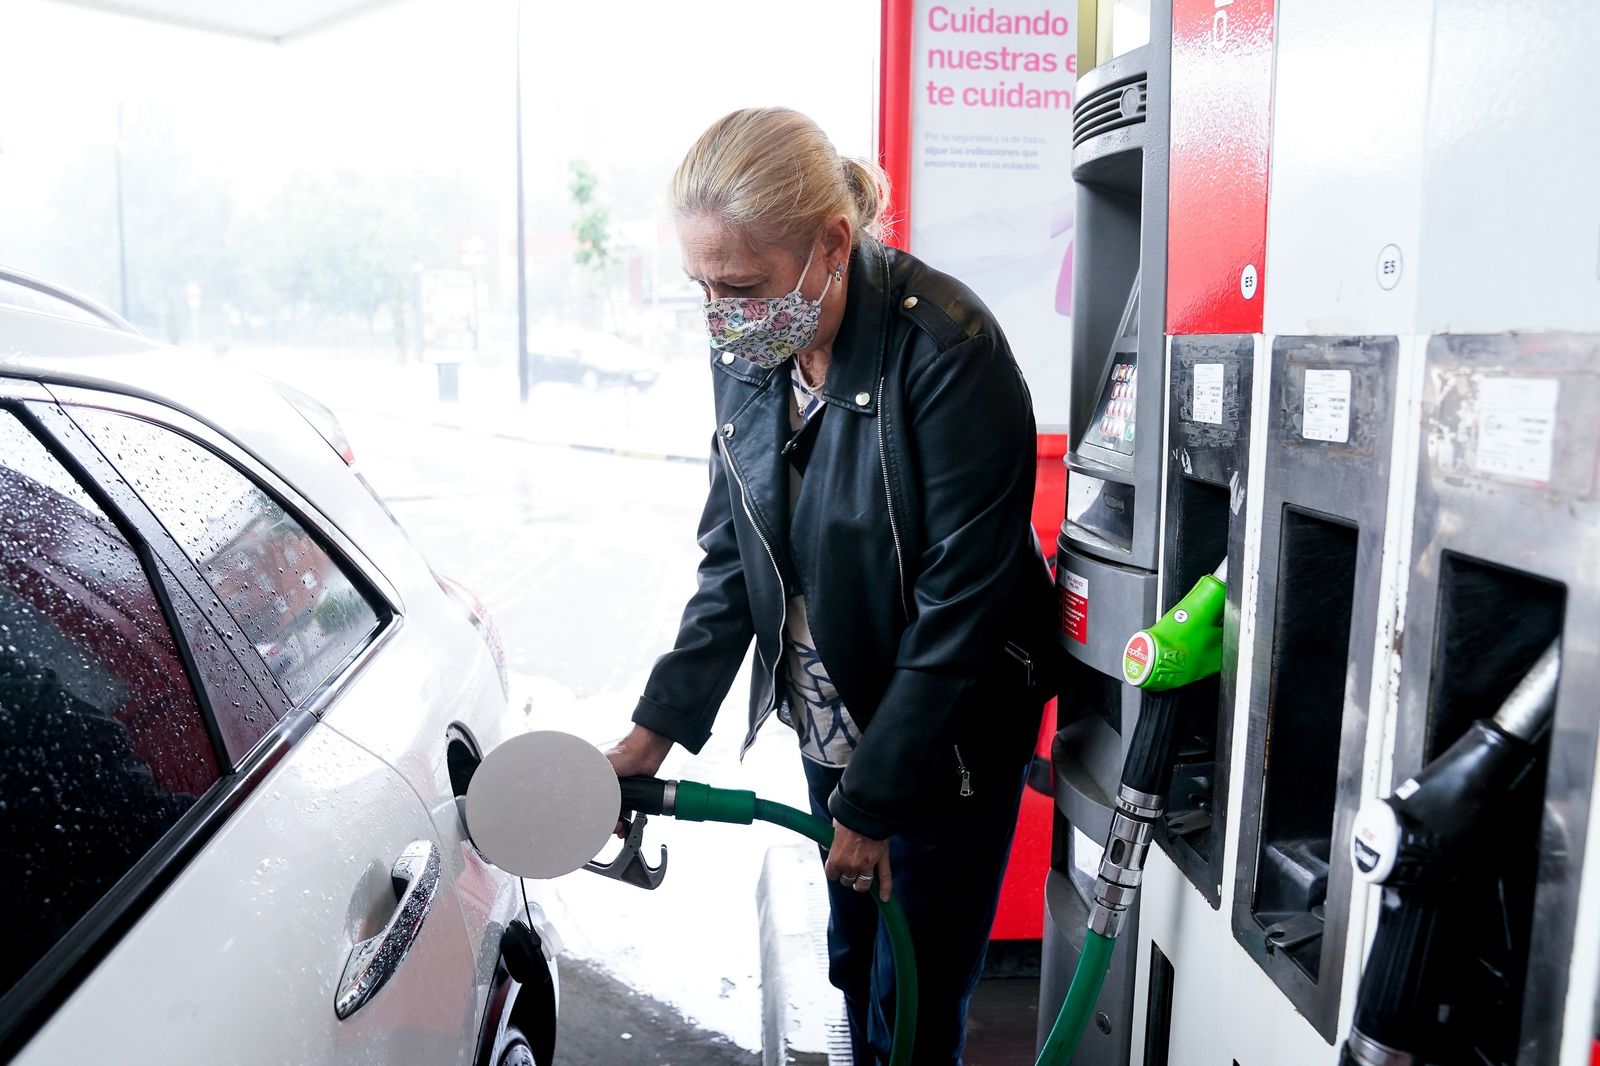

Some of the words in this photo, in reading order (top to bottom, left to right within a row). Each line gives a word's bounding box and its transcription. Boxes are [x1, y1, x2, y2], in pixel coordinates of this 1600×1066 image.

[928, 5, 1069, 36] Cuidando
[927, 46, 1058, 73] nuestras
[926, 80, 955, 106] te
[924, 131, 938, 141] Por
[941, 133, 951, 141] tu
[952, 133, 993, 144] seguridad
[1010, 135, 1021, 143] de
[924, 146, 948, 156] sigue
[950, 146, 963, 155] las
[965, 146, 1020, 157] indicaciones
[1021, 149, 1038, 158] que
[992, 161, 1001, 169] la
[1383, 260, 1395, 274] E5
[1244, 276, 1253, 288] E5
[1127, 661, 1139, 676] 95
